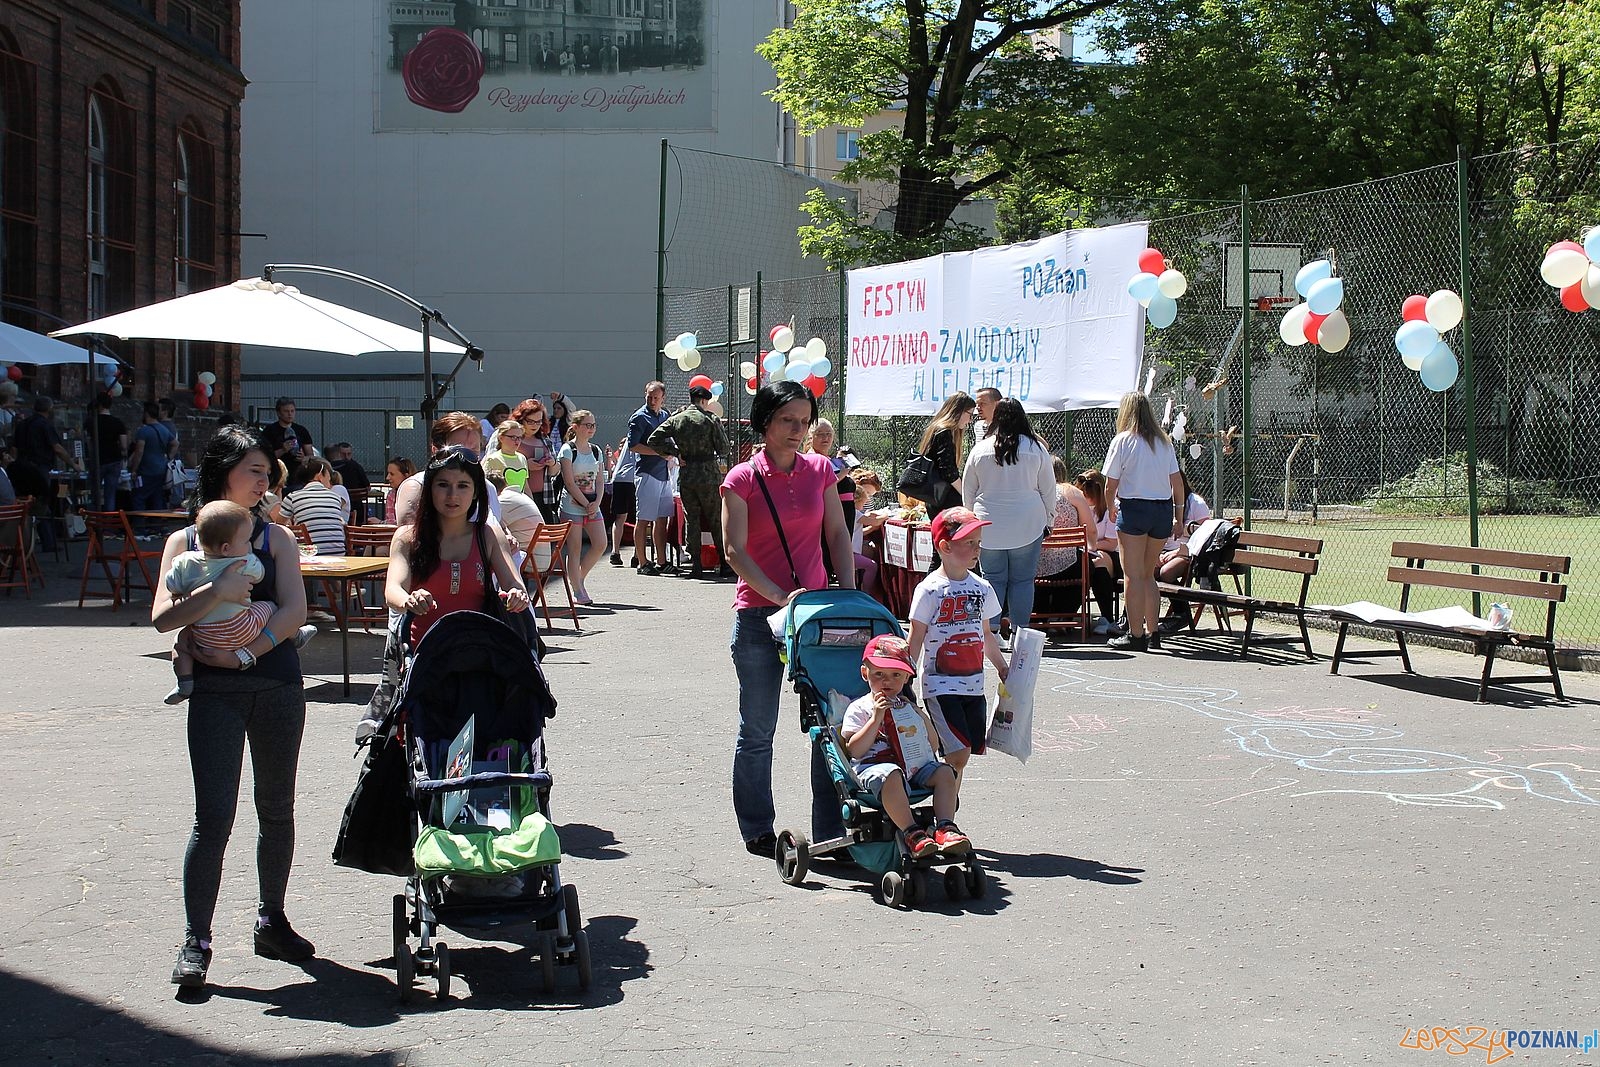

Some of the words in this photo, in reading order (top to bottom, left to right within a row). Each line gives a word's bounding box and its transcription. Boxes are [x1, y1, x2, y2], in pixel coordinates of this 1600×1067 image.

[487, 87, 579, 113] Rezydencje
[864, 278, 926, 317] FESTYN
[852, 327, 1040, 368] RODZINNO-ZAWODOWY
[913, 368, 925, 401] W
[937, 595, 969, 623] 95
